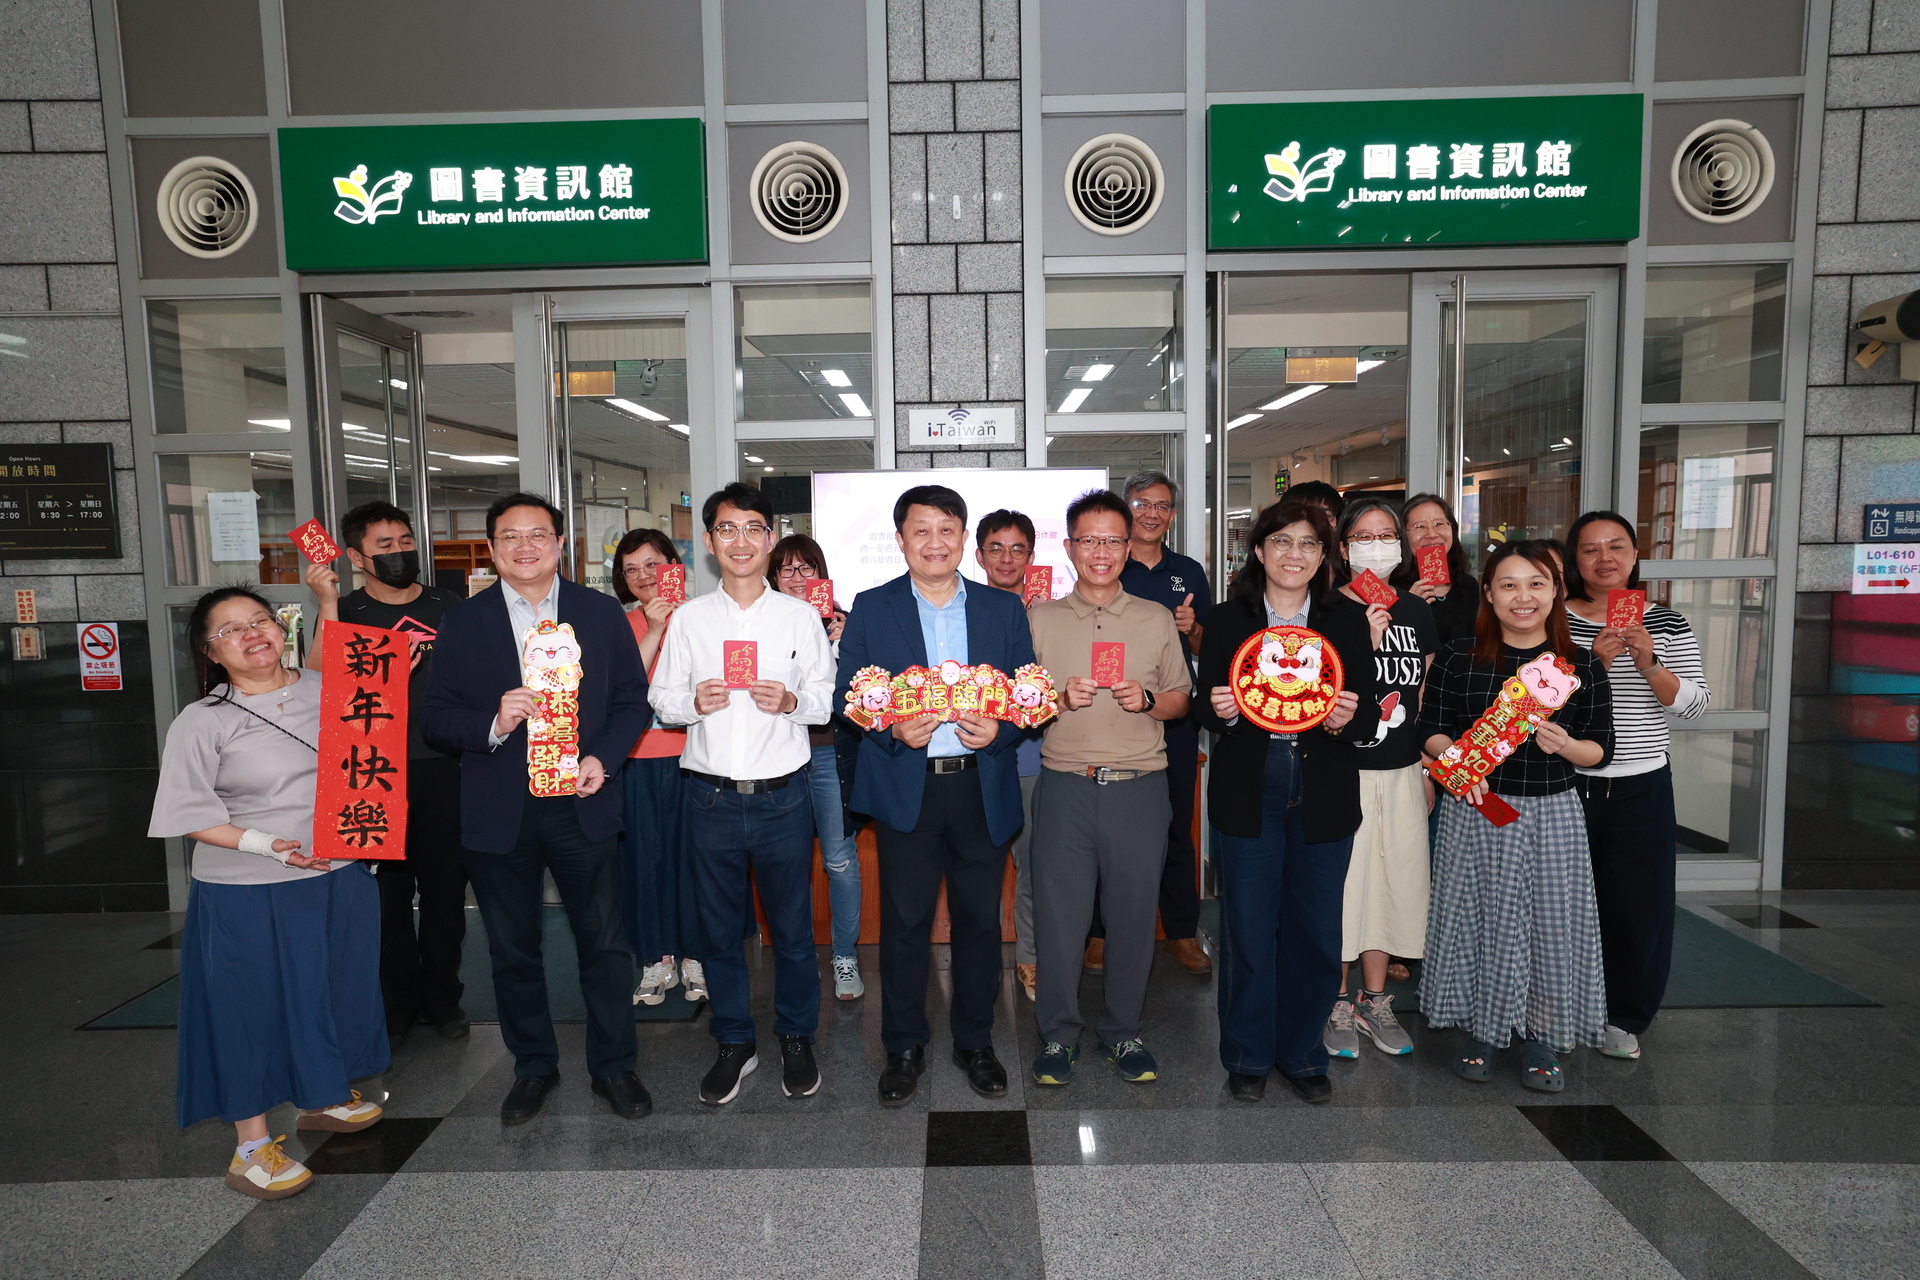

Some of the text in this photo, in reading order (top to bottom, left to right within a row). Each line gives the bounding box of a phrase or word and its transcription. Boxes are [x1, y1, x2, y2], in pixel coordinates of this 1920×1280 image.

[1363, 140, 1572, 180] 圖書資訊館
[430, 163, 633, 203] 圖書資訊館
[1349, 183, 1588, 204] Library and Information Center
[417, 205, 651, 226] Library and Information Center
[0, 464, 57, 477] 開放時間
[80, 500, 102, 508] 星期日
[40, 511, 103, 519] 8:30 17:00
[1867, 550, 1915, 560] L01-610
[893, 684, 1008, 716] 五福臨門
[337, 632, 398, 849] 新年快樂
[534, 691, 577, 795] 恭喜發財
